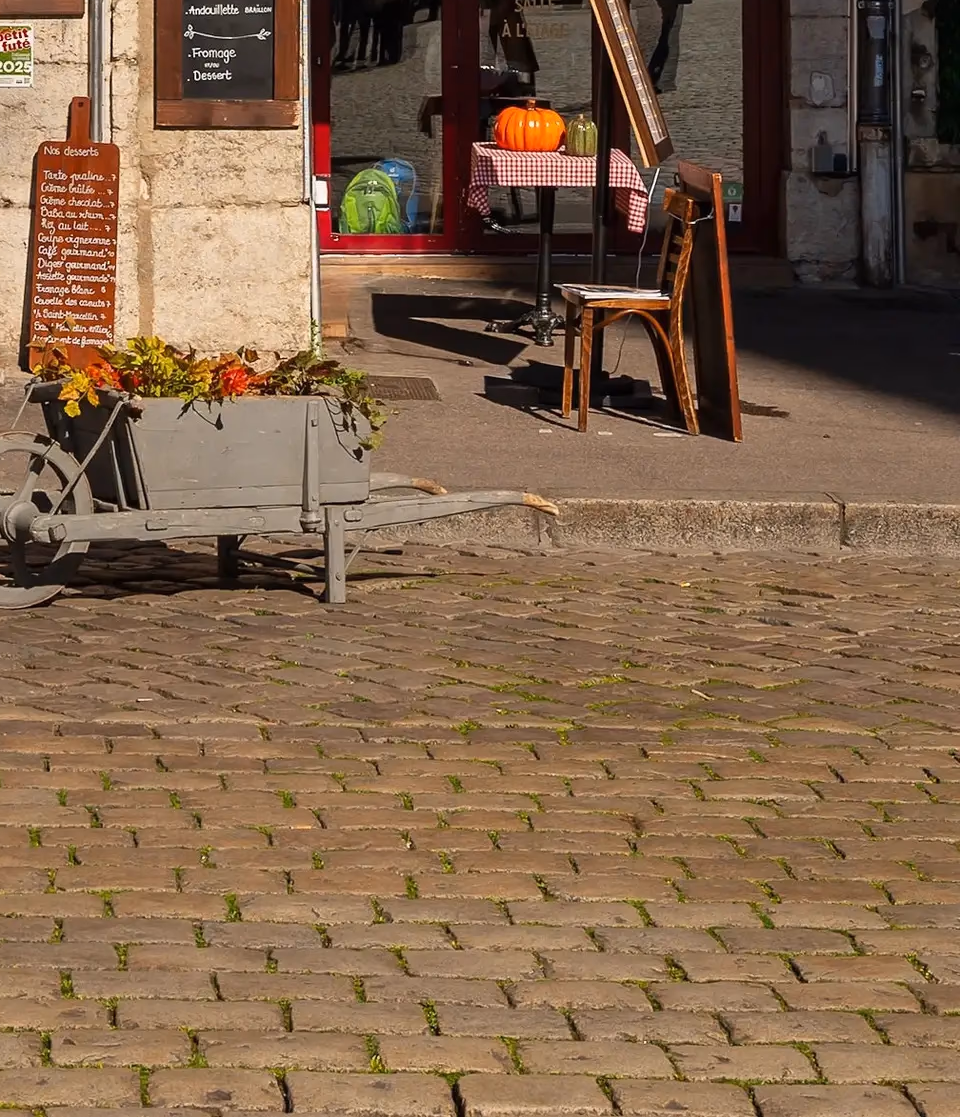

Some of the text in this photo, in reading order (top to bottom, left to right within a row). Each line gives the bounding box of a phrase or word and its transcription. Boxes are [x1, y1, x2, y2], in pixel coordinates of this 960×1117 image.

[188, 4, 240, 16] Andouillette
[501, 19, 512, 38] À
[2, 37, 31, 53] futé
[192, 47, 236, 64] Fromage
[193, 70, 232, 82] Dessert
[43, 146, 100, 157] Nos desserts
[43, 169, 68, 181] Tarte
[69, 170, 105, 185] praline
[67, 196, 104, 208] chocolat
[40, 206, 65, 218] Baba
[65, 211, 77, 219] au
[58, 222, 72, 230] au
[73, 221, 89, 231] lait
[38, 245, 58, 259] Café
[71, 284, 96, 295] blanc
[65, 297, 78, 306] des
[79, 299, 106, 308] canuts
